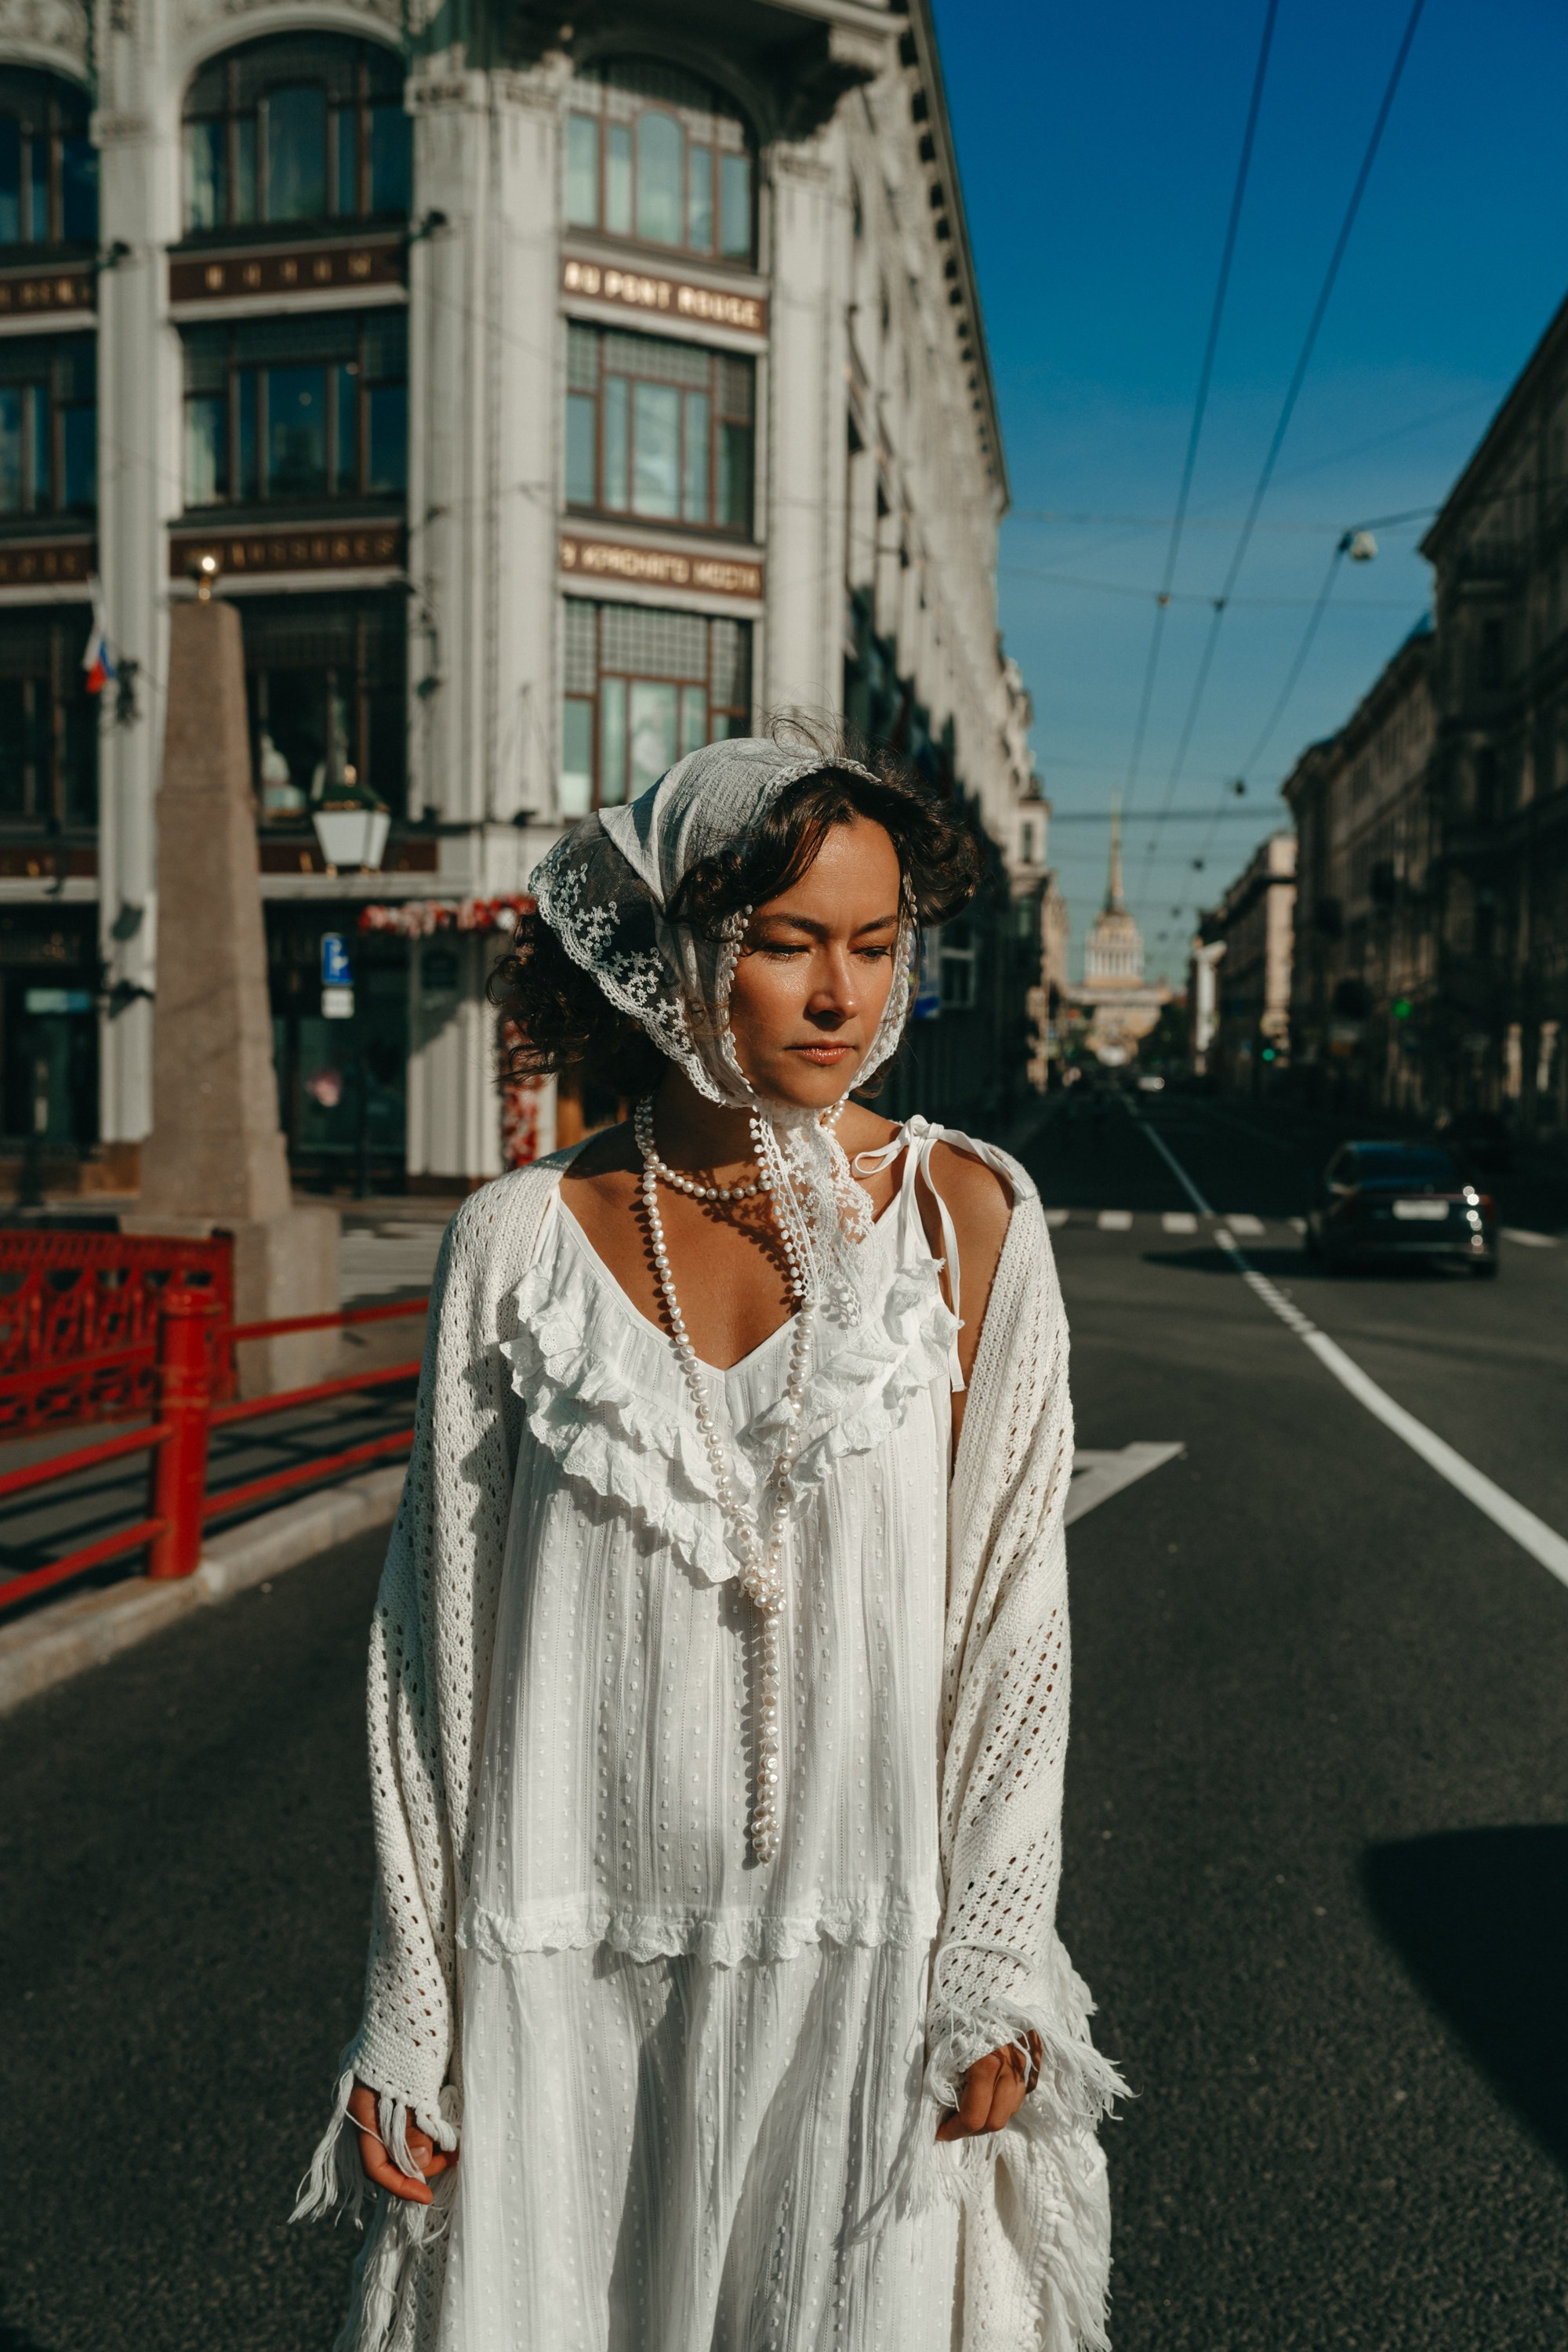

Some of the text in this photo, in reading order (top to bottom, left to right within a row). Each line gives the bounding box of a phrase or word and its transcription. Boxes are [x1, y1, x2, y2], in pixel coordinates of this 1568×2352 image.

[565, 263, 760, 328] AU PONT ROUGE
